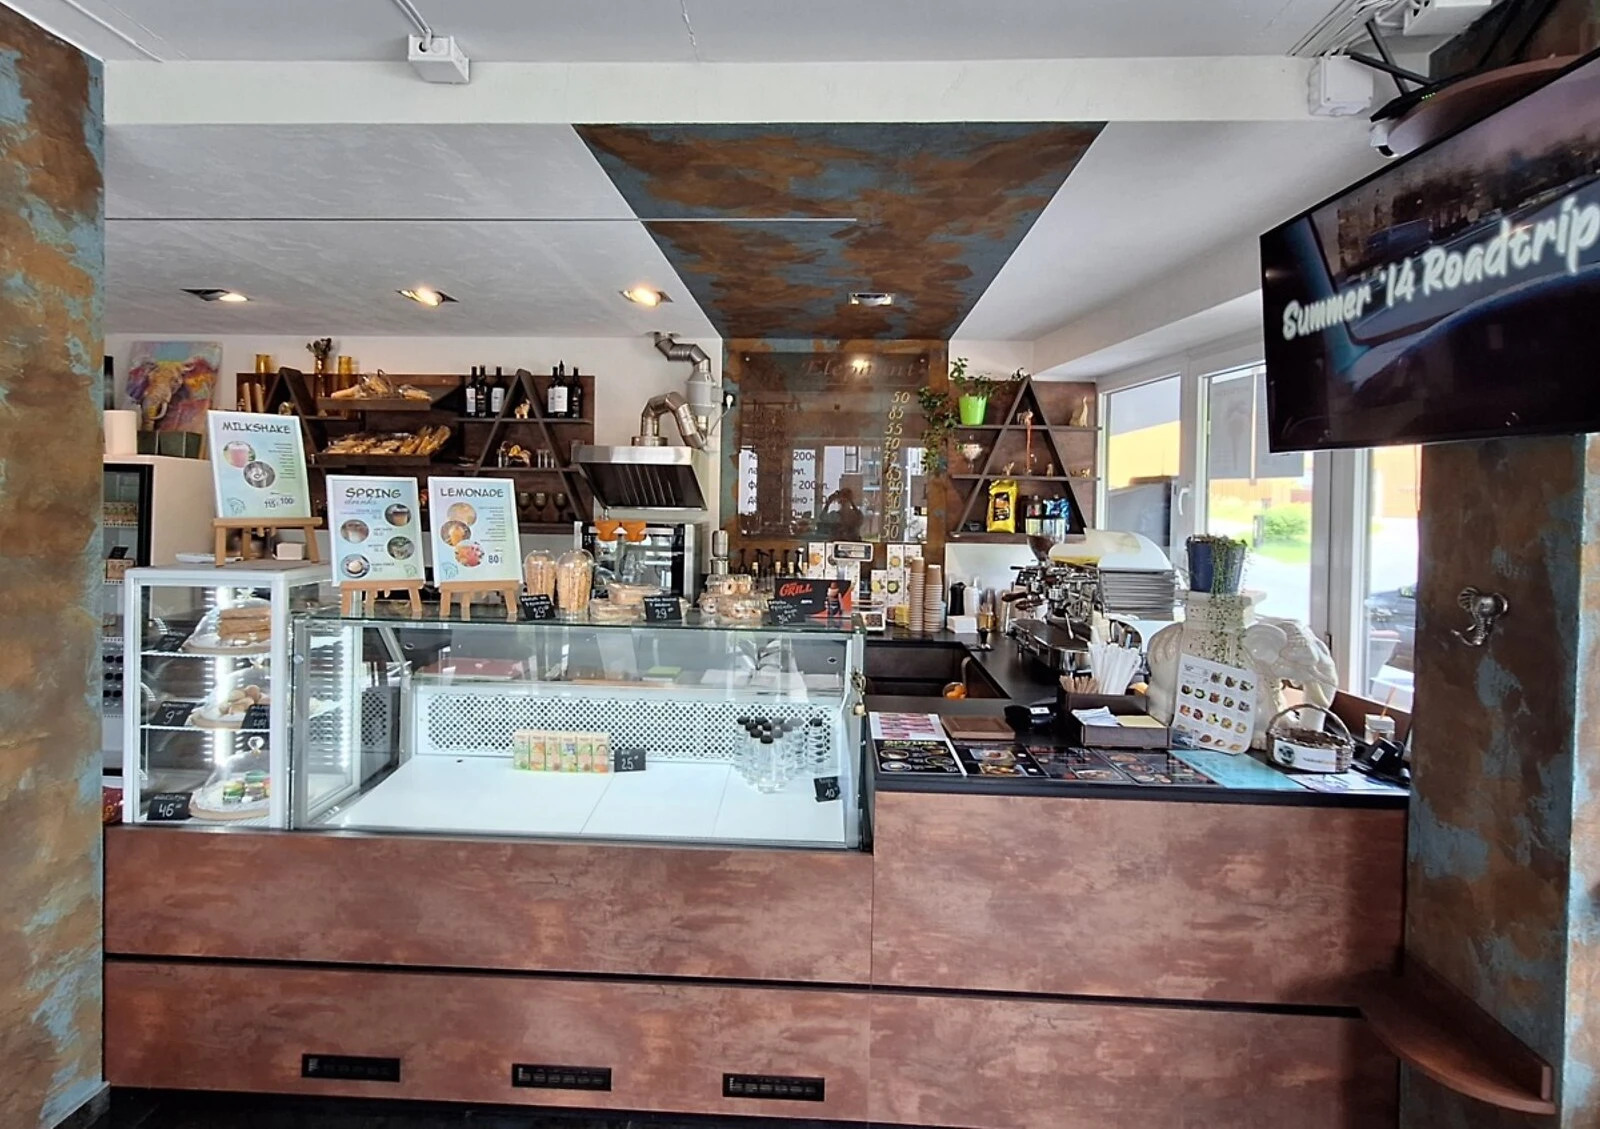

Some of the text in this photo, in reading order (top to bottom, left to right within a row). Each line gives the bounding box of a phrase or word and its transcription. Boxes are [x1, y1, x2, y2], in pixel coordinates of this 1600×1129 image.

[1283, 195, 1600, 341] Summer '14 Roadtrip
[891, 391, 911, 404] 50
[222, 422, 291, 434] MILKSHAKE
[884, 422, 903, 436] 55
[345, 487, 401, 499] SPRING
[440, 487, 504, 498] LEMONADE
[779, 583, 813, 597] GRILL
[158, 803, 175, 817] 46
